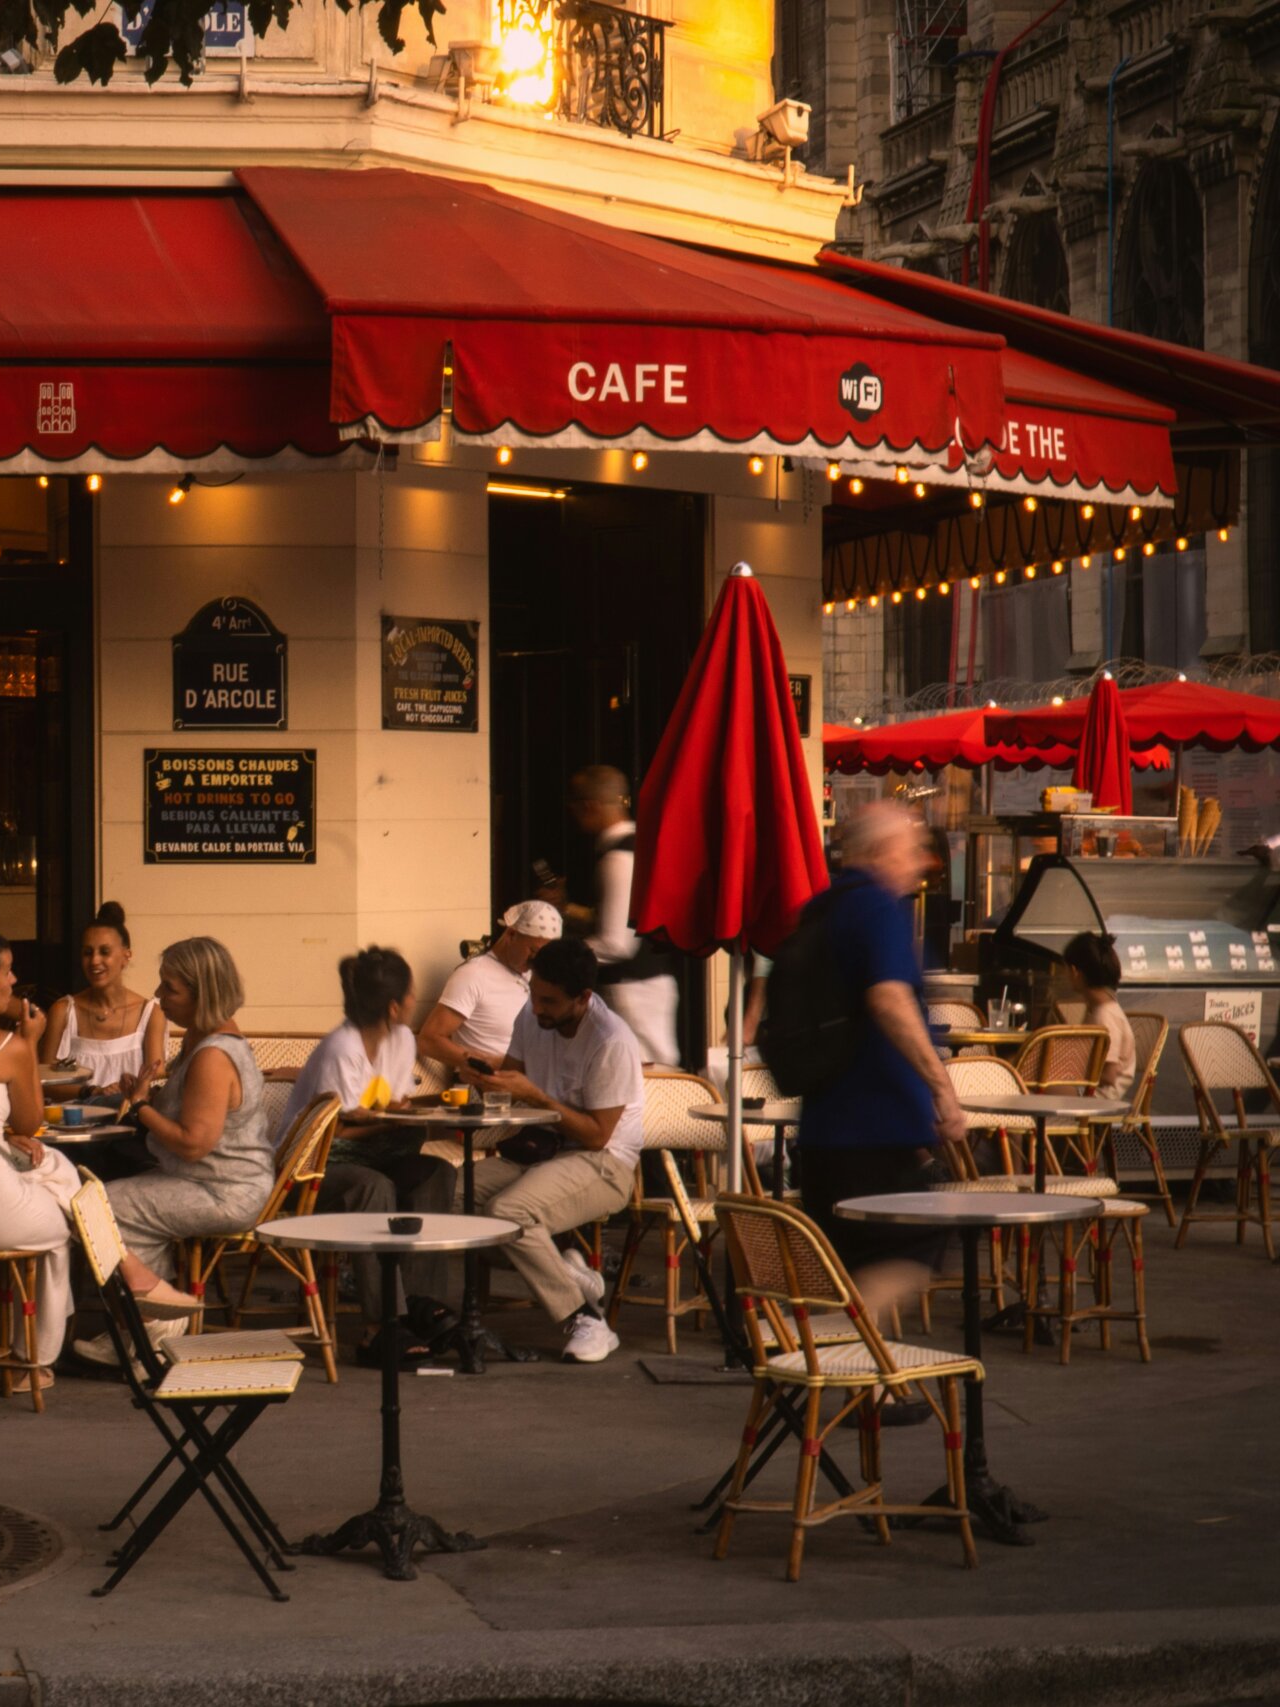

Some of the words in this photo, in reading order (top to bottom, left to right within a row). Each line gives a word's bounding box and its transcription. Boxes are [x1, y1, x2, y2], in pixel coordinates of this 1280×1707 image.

[566, 361, 688, 404] CAFE
[1025, 424, 1067, 461] THE
[451, 638, 472, 672] BEERS
[213, 663, 249, 682] RUE
[394, 687, 418, 700] FRESH
[421, 688, 441, 701] FRUIT
[444, 689, 467, 703] JUICES
[406, 713, 418, 722] HOT
[420, 714, 454, 724] CHOCOLATE
[162, 759, 234, 772] BOISSONS
[239, 759, 299, 772] CHAUDES
[184, 774, 194, 786] A
[201, 774, 274, 786] EMPORTER
[164, 792, 192, 805] HOT
[197, 793, 245, 806] DRINKS
[250, 793, 271, 806] TO
[274, 793, 295, 806] GO
[161, 810, 215, 821] BEBIDAS
[186, 823, 221, 834] PARA
[226, 823, 276, 834] LLEVAR
[155, 842, 199, 853] BEVANDE
[202, 842, 231, 853] CALDE
[235, 842, 246, 853] DA
[247, 842, 284, 853] PORTARE
[288, 842, 305, 853] VIA
